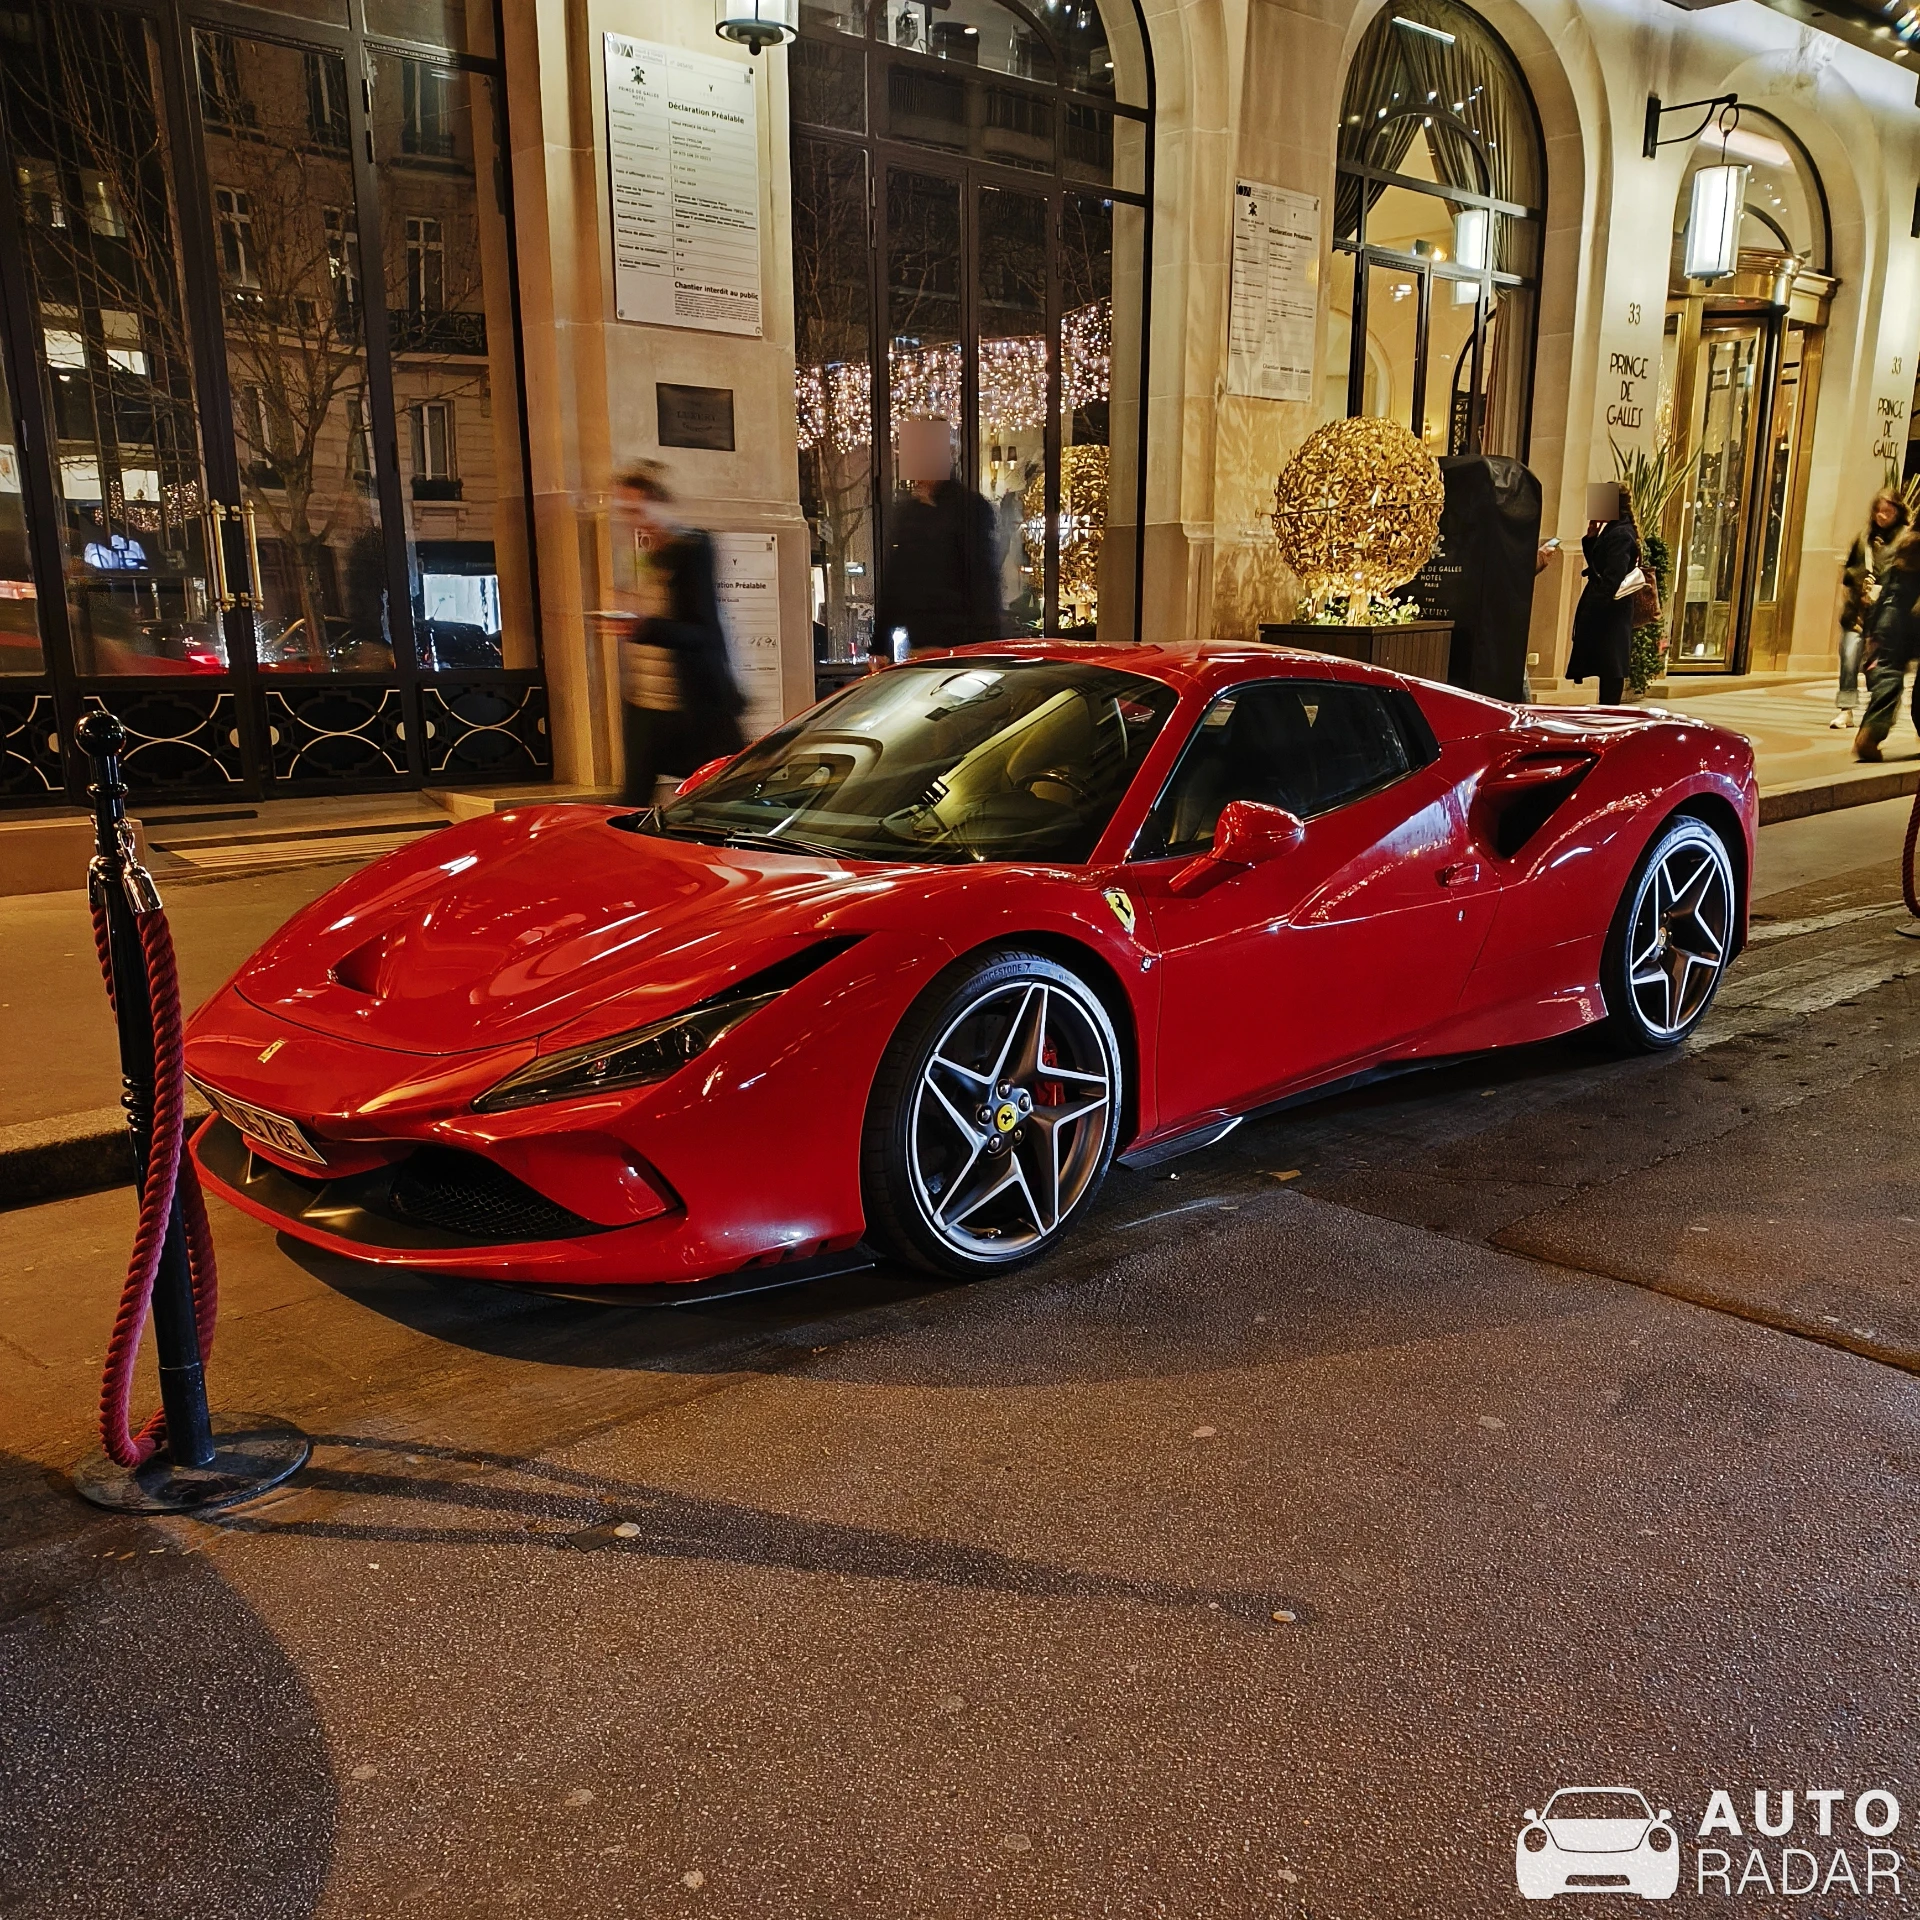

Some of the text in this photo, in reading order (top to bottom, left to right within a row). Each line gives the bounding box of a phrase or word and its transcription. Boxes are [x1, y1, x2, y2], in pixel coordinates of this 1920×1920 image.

[668, 101, 745, 125] Déclaration Préalable
[674, 280, 759, 301] Chantier interdit au public
[1628, 302, 1641, 325] 33
[1609, 352, 1649, 379] PRINCE
[1892, 356, 1902, 375] 33
[1620, 380, 1635, 402] DE
[1606, 404, 1644, 428] GALLES
[1877, 397, 1905, 419] PRINCE
[1882, 420, 1893, 438] DE
[1873, 439, 1899, 460] GALLES
[1428, 565, 1436, 573] DE
[1438, 565, 1462, 573] GALLES
[735, 582, 767, 590] Préalable
[1422, 607, 1449, 617] XURY
[252, 1112, 308, 1155] 785
